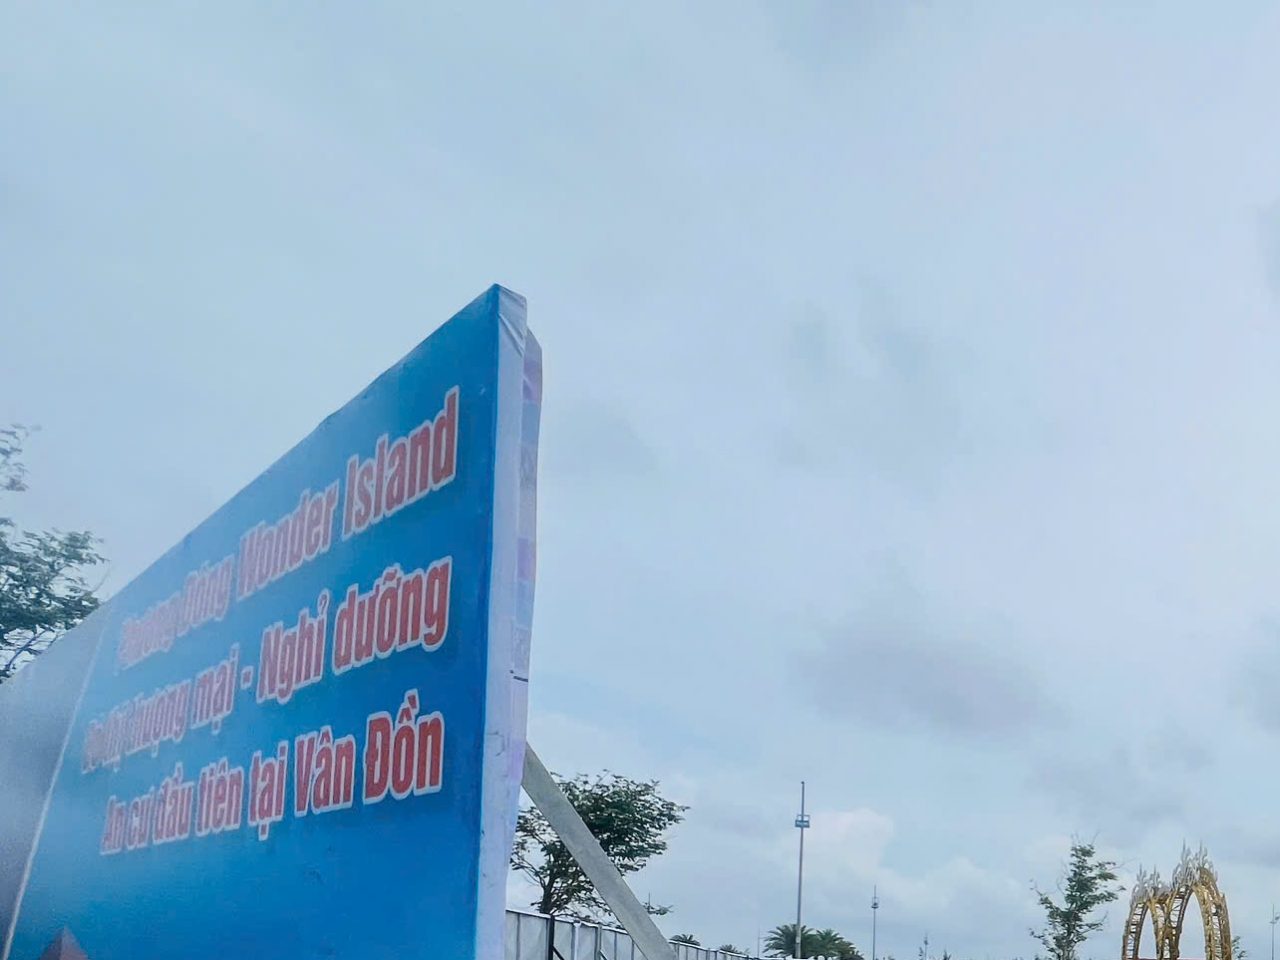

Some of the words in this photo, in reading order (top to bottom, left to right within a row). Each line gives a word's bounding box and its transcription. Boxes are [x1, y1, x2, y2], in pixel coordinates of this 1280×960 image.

[237, 480, 339, 601] Wonder
[342, 385, 459, 540] Island
[191, 642, 240, 735] mại
[256, 588, 330, 704] Nghỉ
[332, 555, 453, 677] dưỡng
[195, 756, 245, 836] tiên
[248, 740, 289, 840] tại
[295, 725, 356, 817] Vân
[363, 688, 445, 805] Đồn
